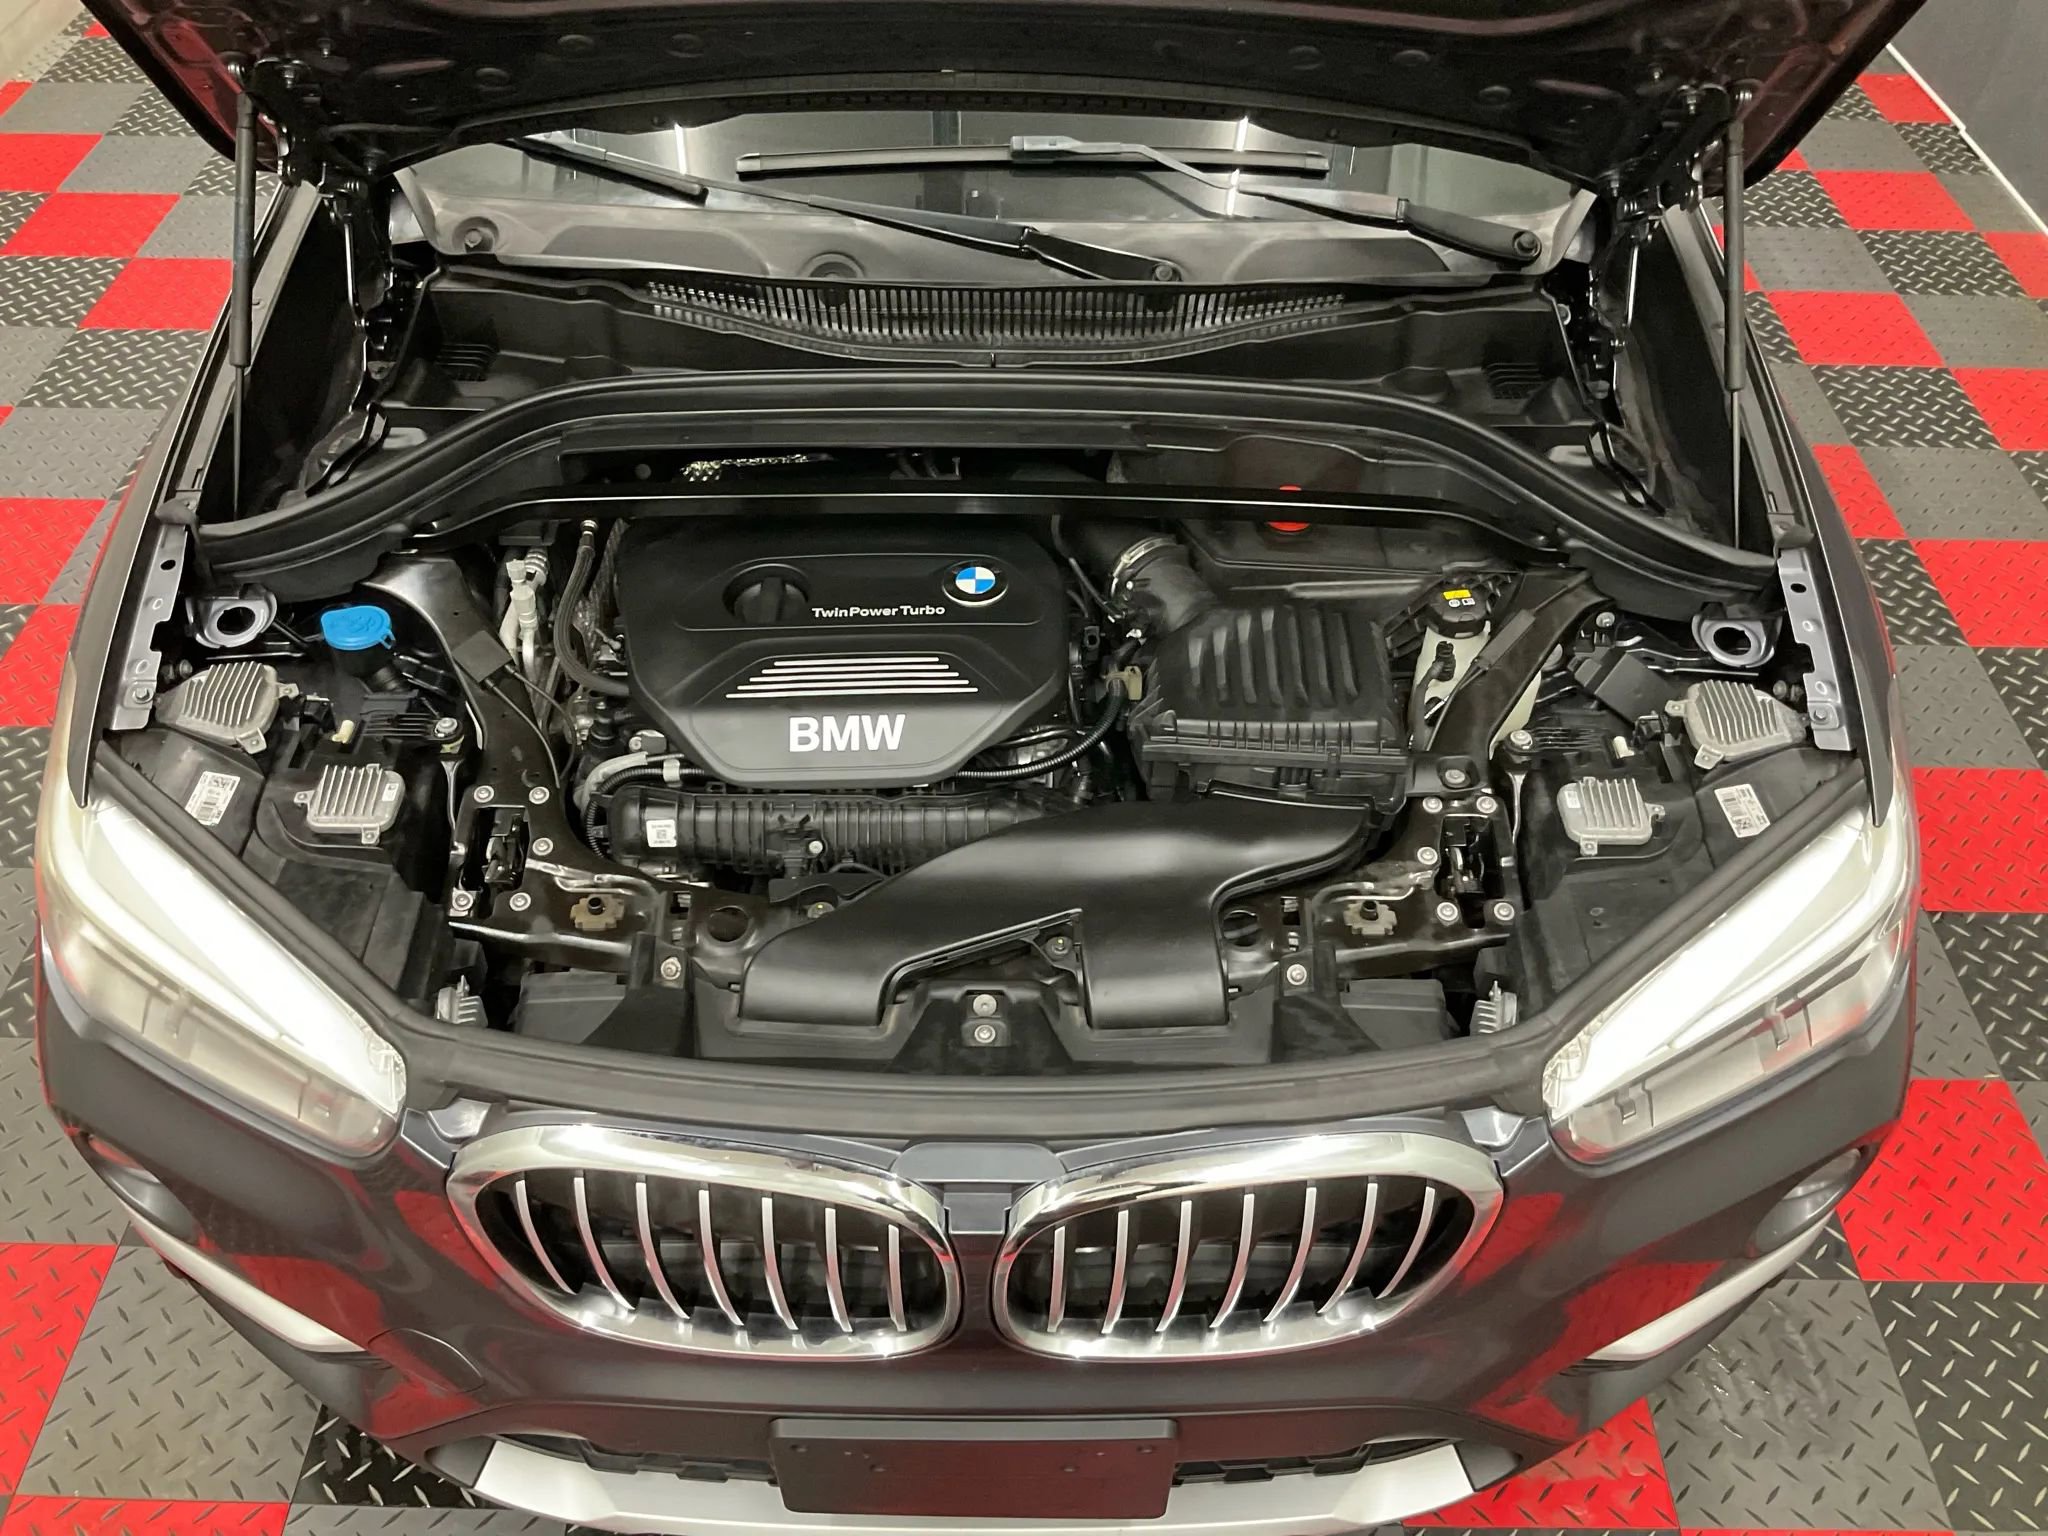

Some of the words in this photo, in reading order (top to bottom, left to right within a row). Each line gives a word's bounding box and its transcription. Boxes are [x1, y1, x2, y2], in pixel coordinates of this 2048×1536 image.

[811, 606, 899, 618] TwinPower
[900, 605, 946, 616] Turbo
[789, 714, 906, 752] BMW
